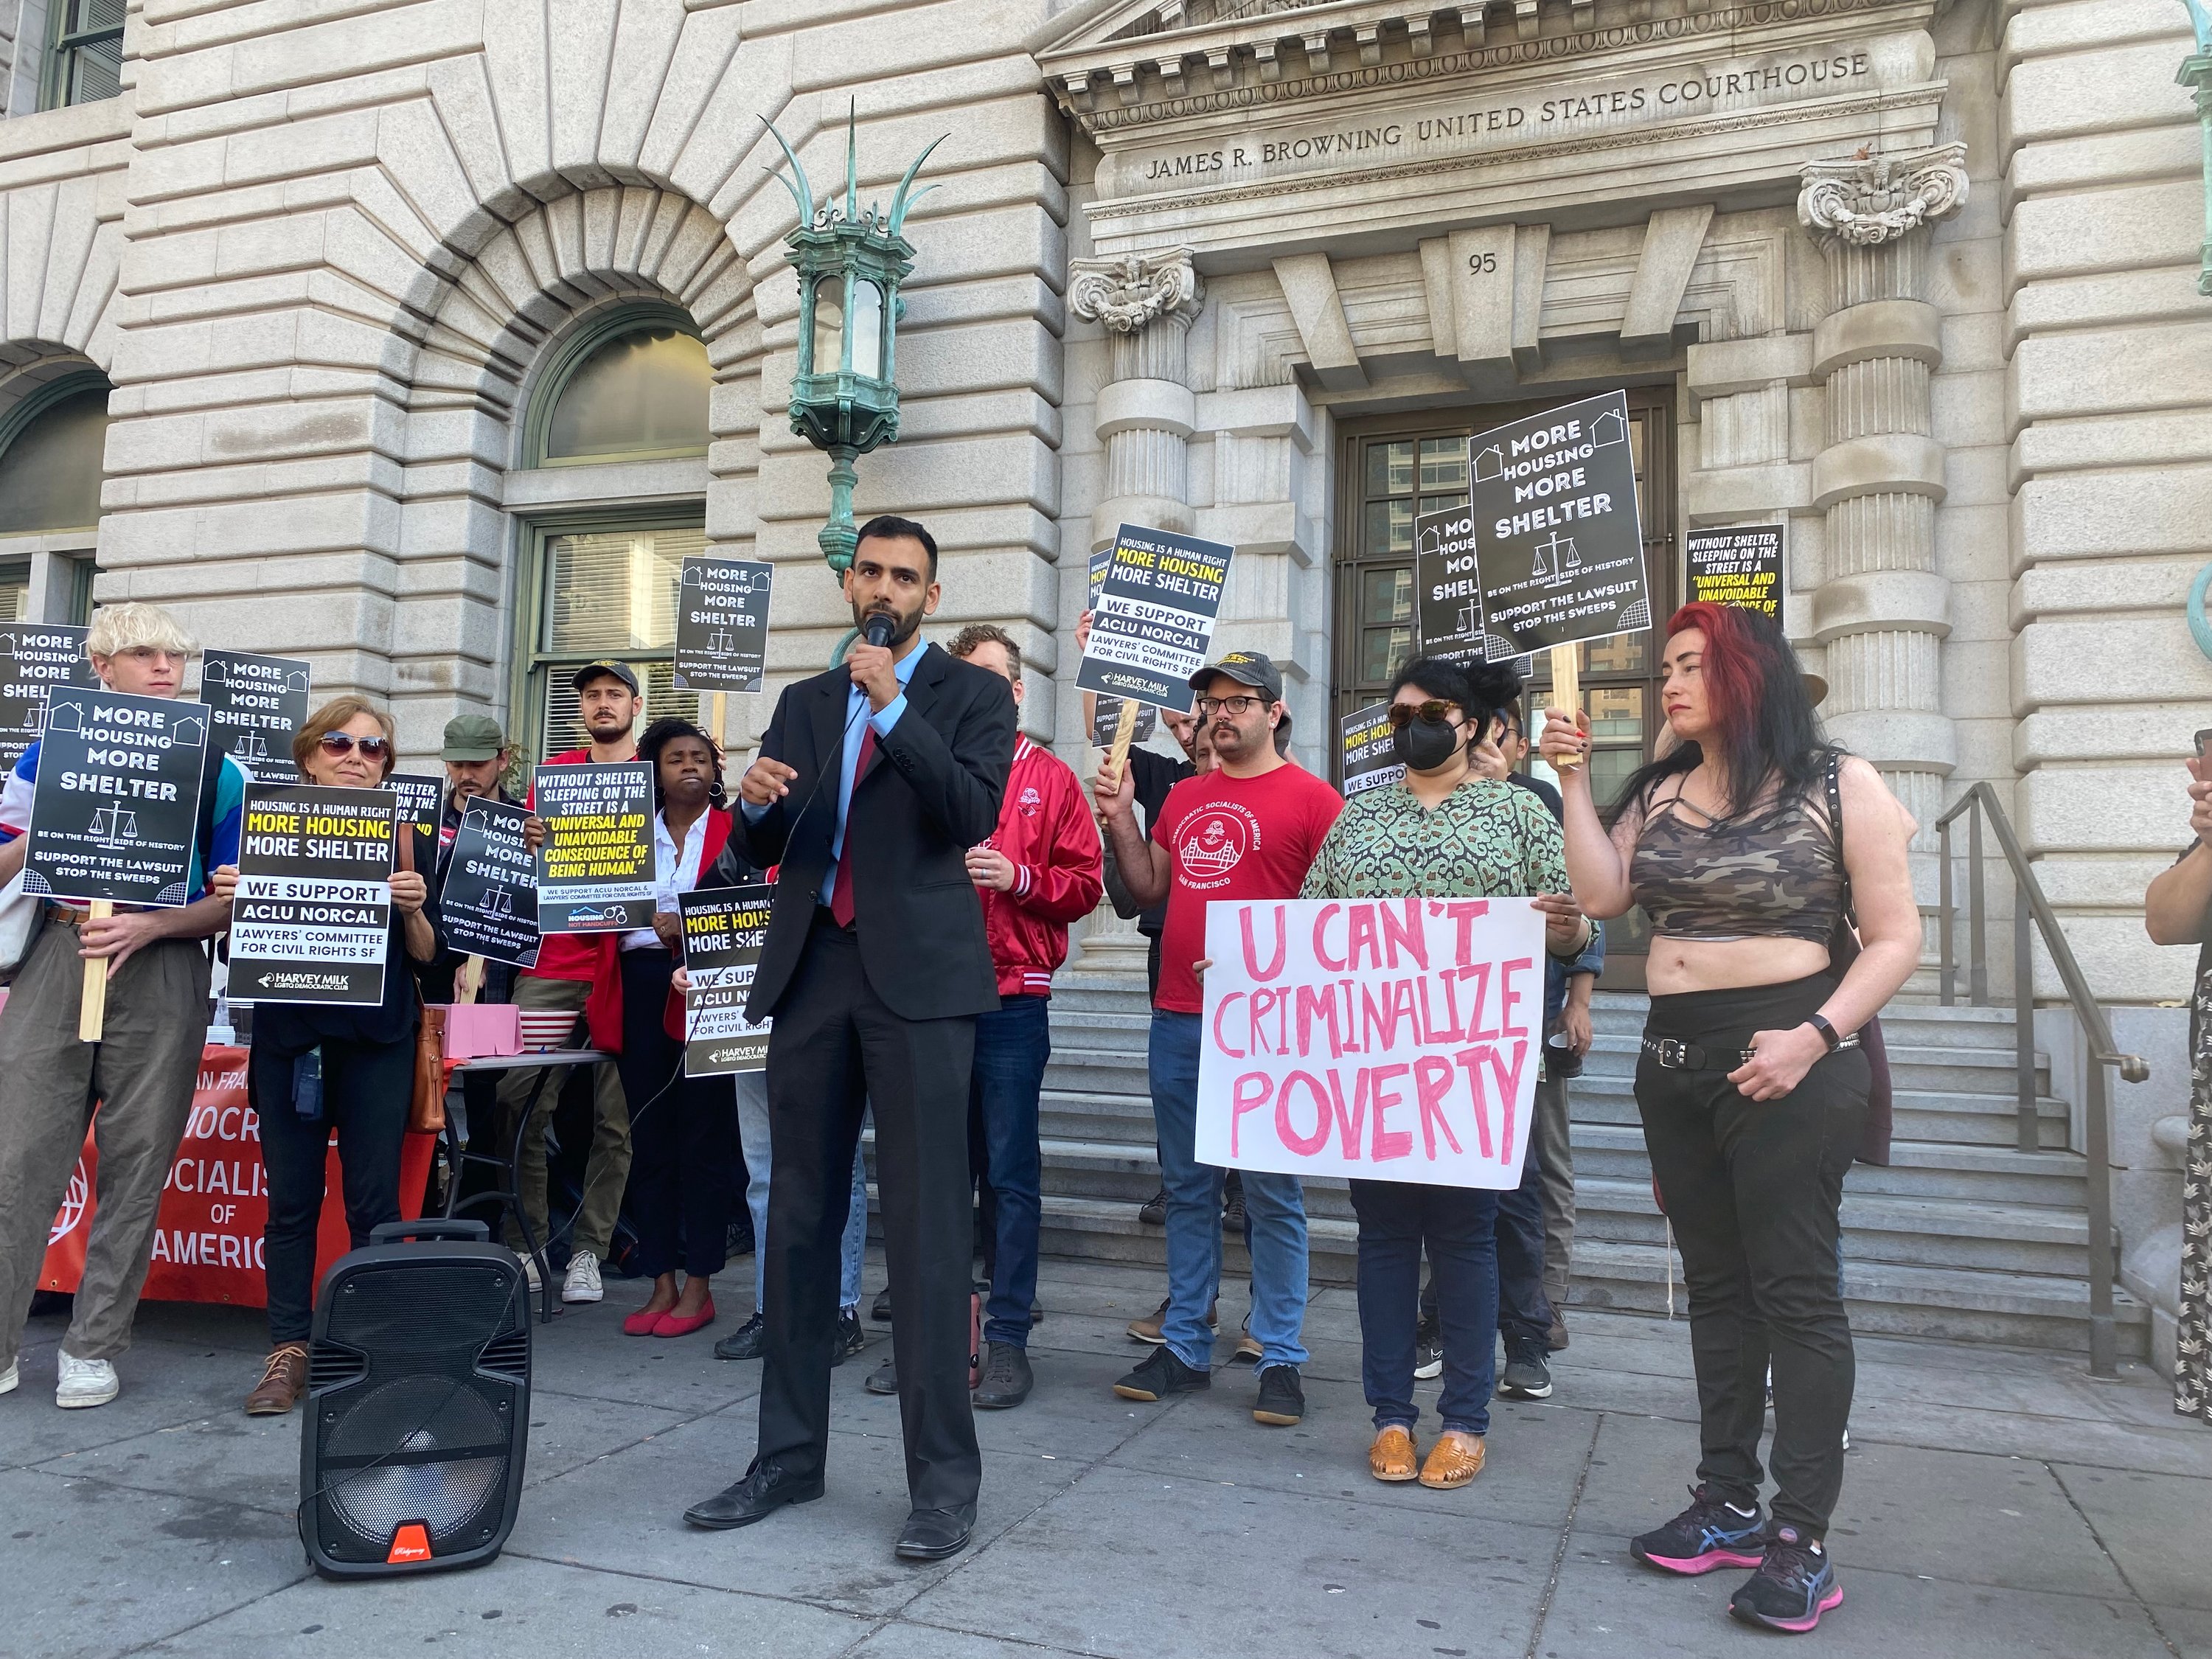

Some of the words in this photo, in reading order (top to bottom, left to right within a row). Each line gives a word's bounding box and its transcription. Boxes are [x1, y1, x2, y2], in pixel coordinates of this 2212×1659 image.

[1146, 150, 1223, 179] JAMES
[1233, 148, 1253, 167] R.
[1262, 125, 1402, 163] BROWNING
[1417, 108, 1525, 141] UNITED
[1541, 88, 1646, 122] STATES
[1659, 53, 1869, 103] COURTHOUSE
[1470, 253, 1496, 275] 95
[1512, 420, 1582, 457] MORE
[1503, 443, 1594, 481] HOUSING
[1515, 467, 1586, 503] MORE
[1495, 493, 1612, 539] SHELTER
[1688, 536, 1732, 550] WITHOUT
[1734, 533, 1778, 547] SHELTER,
[1121, 537, 1155, 552] HOUSING
[1157, 544, 1165, 552] IS
[1166, 547, 1172, 555] A
[1175, 548, 1201, 562] HUMAN
[1203, 555, 1227, 568] RIGHT
[1692, 549, 1737, 563] SLEEPING
[1740, 548, 1755, 559] ON
[1759, 546, 1778, 558] THE
[707, 568, 748, 581] MORE
[1116, 547, 1156, 568] MORE
[1158, 555, 1224, 584] HOUSING
[1705, 561, 1740, 574] STREET
[1742, 561, 1753, 572] IS
[1754, 560, 1761, 571] A
[1111, 564, 1152, 585] MORE
[1155, 574, 1220, 602] SHELTER
[1487, 590, 1498, 598] BE
[1499, 586, 1512, 594] ON
[1513, 581, 1528, 590] THE
[1529, 574, 1556, 587] RIGHT
[1559, 568, 1579, 580] SIDE
[1582, 565, 1593, 574] OF
[1596, 557, 1634, 571] HISTORY
[1752, 572, 1775, 585] AND
[700, 582, 751, 594] HOUSING
[1698, 587, 1769, 602] UNAVOIDABLE
[704, 595, 745, 608] MORE
[1490, 599, 1547, 623] SUPPORT
[1550, 594, 1574, 608] THE
[1577, 580, 1638, 602] LAWSUIT
[690, 611, 755, 627] SHELTER
[1107, 599, 1130, 615] WE
[1135, 605, 1206, 632] SUPPORT
[1513, 617, 1542, 633] STOP
[1544, 611, 1565, 623] THE
[1568, 600, 1616, 619] SWEEPS
[22, 634, 72, 648] MORE
[1099, 618, 1138, 633] ACLU
[1141, 625, 1200, 650] NORCAL
[14, 651, 78, 663] HOUSING
[1093, 646, 1113, 658] FOR
[1116, 651, 1140, 662] CIVIL
[1143, 656, 1178, 672] RIGHTS
[1182, 667, 1194, 675] SF
[1142, 645, 1201, 667] COMMITTEE
[20, 666, 70, 680] MORE
[234, 663, 282, 680] MORE
[225, 679, 287, 694] HOUSING
[1113, 672, 1148, 686] HARVEY
[1149, 682, 1169, 692] MILK
[231, 693, 279, 709] MORE
[93, 705, 165, 729] MORE
[214, 711, 292, 731] SHELTER
[80, 727, 172, 748] HOUSING
[1346, 730, 1368, 750] MORE
[87, 748, 159, 771] MORE
[1346, 745, 1369, 765] MORE
[60, 772, 177, 801] SHELTER
[538, 773, 592, 787] WITHOUT
[595, 771, 647, 786] SHELTER,
[1348, 779, 1363, 792] WE
[544, 787, 599, 801] SLEEPING
[603, 787, 620, 799] ON
[625, 786, 646, 799] THE
[250, 800, 296, 812] HOUSING
[299, 803, 310, 813] IS
[313, 804, 319, 814] A
[323, 804, 358, 816] HUMAN
[361, 807, 391, 818] RIGHT
[561, 801, 603, 815] STREET
[607, 801, 619, 813] IS
[621, 801, 628, 813] A
[248, 813, 300, 833] MORE
[306, 817, 390, 839] HOUSING
[619, 815, 645, 829] AND
[1172, 806, 1203, 844] DEMOCRATIC
[1206, 801, 1247, 813] SOCIALISTS
[1245, 811, 1253, 821] OF
[1250, 818, 1261, 851] AMERICA
[66, 833, 81, 841] THE
[83, 835, 110, 844] RIGHT
[149, 841, 185, 851] HISTORY
[554, 830, 638, 846] UNAVOIDABLE
[246, 835, 299, 857] MORE
[305, 839, 388, 862] SHELTER
[485, 844, 533, 867] MORE
[544, 846, 630, 863] CONSEQUENCE
[633, 845, 648, 859] OF
[35, 851, 97, 865] SUPPORT
[100, 858, 123, 867] THE
[126, 860, 184, 873] LAWSUIT
[549, 863, 585, 877] BEING
[56, 867, 87, 877] STOP
[90, 871, 111, 880] THE
[114, 872, 159, 884] SWEEPS
[1178, 874, 1189, 886] SAN
[1188, 877, 1231, 889] FRANCISCO
[247, 882, 279, 897] WE
[286, 884, 380, 902] SUPPORT
[242, 904, 293, 919] ACLU
[299, 908, 378, 924] NORCAL
[686, 914, 728, 933] MORE
[305, 932, 383, 945] COMMITTEE
[689, 933, 731, 953] MORE
[1239, 905, 1286, 982] U
[1312, 897, 1489, 972] CAN'T
[241, 943, 267, 953] FOR
[272, 945, 305, 955] CIVIL
[309, 946, 356, 956] RIGHTS
[361, 948, 375, 957] SF
[275, 973, 321, 984] HARVEY
[321, 975, 349, 984] MILK
[1214, 957, 1533, 1060] CRIMINALIZE
[1231, 1040, 1528, 1166] POVERTY
[211, 1203, 237, 1225] OF
[151, 1230, 266, 1270] AMERIC
